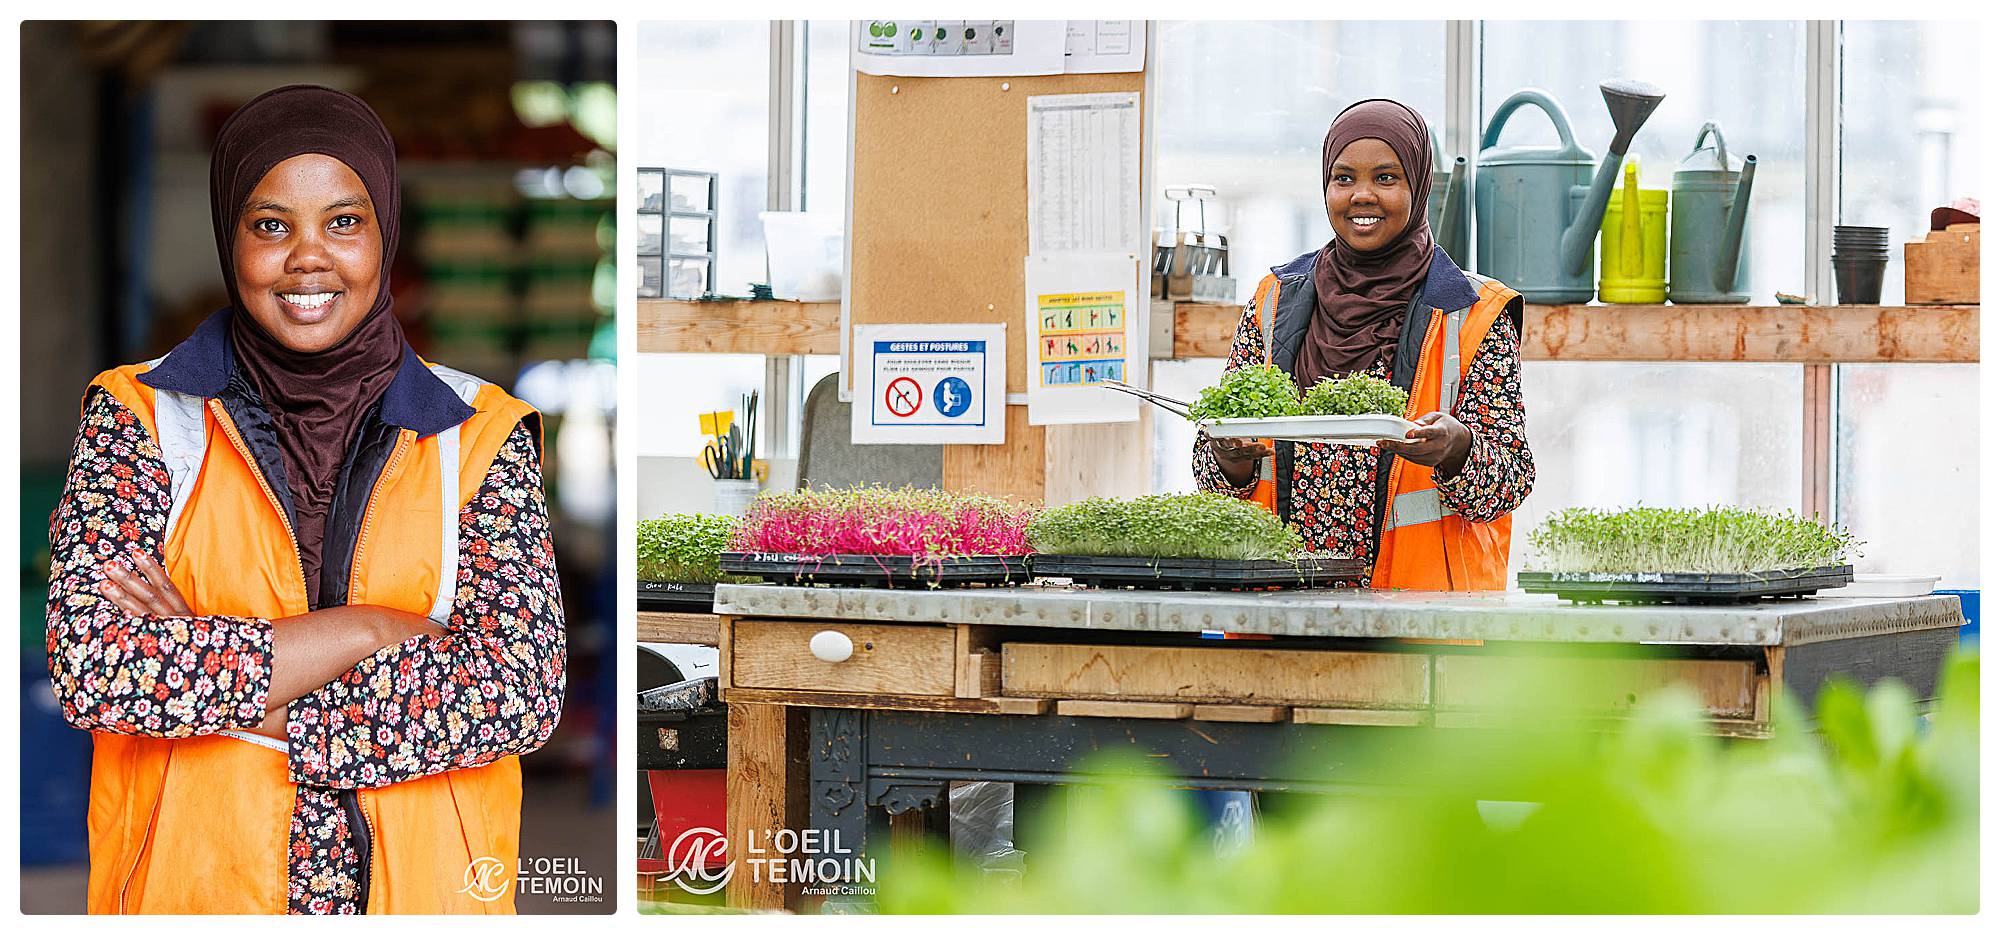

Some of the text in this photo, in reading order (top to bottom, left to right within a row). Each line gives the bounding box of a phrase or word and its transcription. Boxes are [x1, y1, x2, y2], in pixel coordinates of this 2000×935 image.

[889, 342, 969, 352] GESTES ET POSTURES
